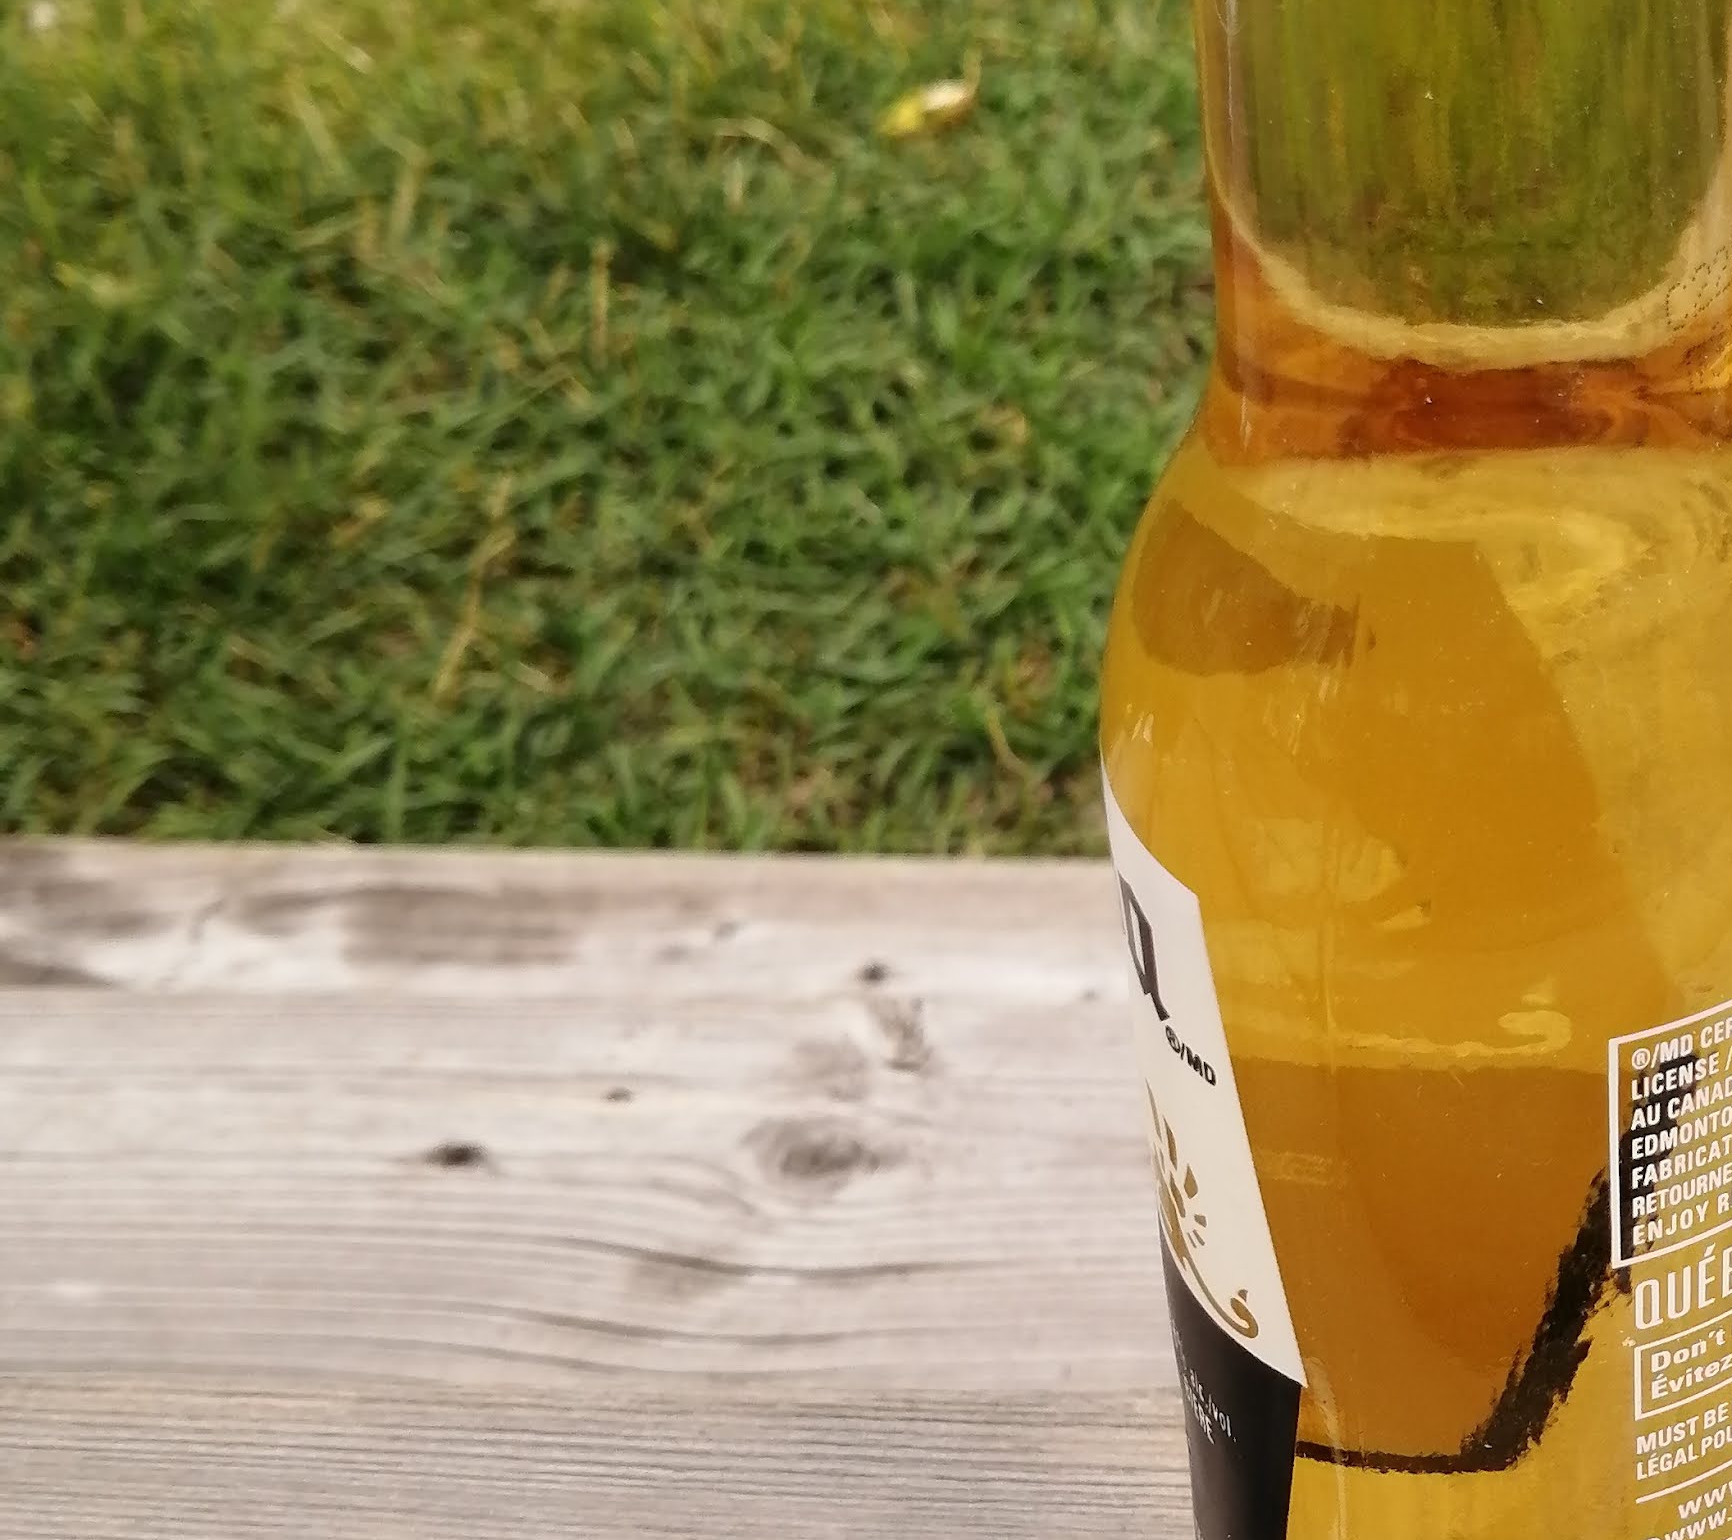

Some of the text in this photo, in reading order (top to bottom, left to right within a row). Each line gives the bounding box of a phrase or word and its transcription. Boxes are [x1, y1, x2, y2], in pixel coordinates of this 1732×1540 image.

[1631, 1052, 1720, 1101] LICENSE
[1631, 1102, 1661, 1131] AU
[1632, 1204, 1708, 1246] ENJOY
[1650, 1326, 1726, 1373] Don't
[1635, 1417, 1698, 1456] MUST
[1703, 1405, 1729, 1437] BE
[1636, 1441, 1701, 1482] LÉGAL
